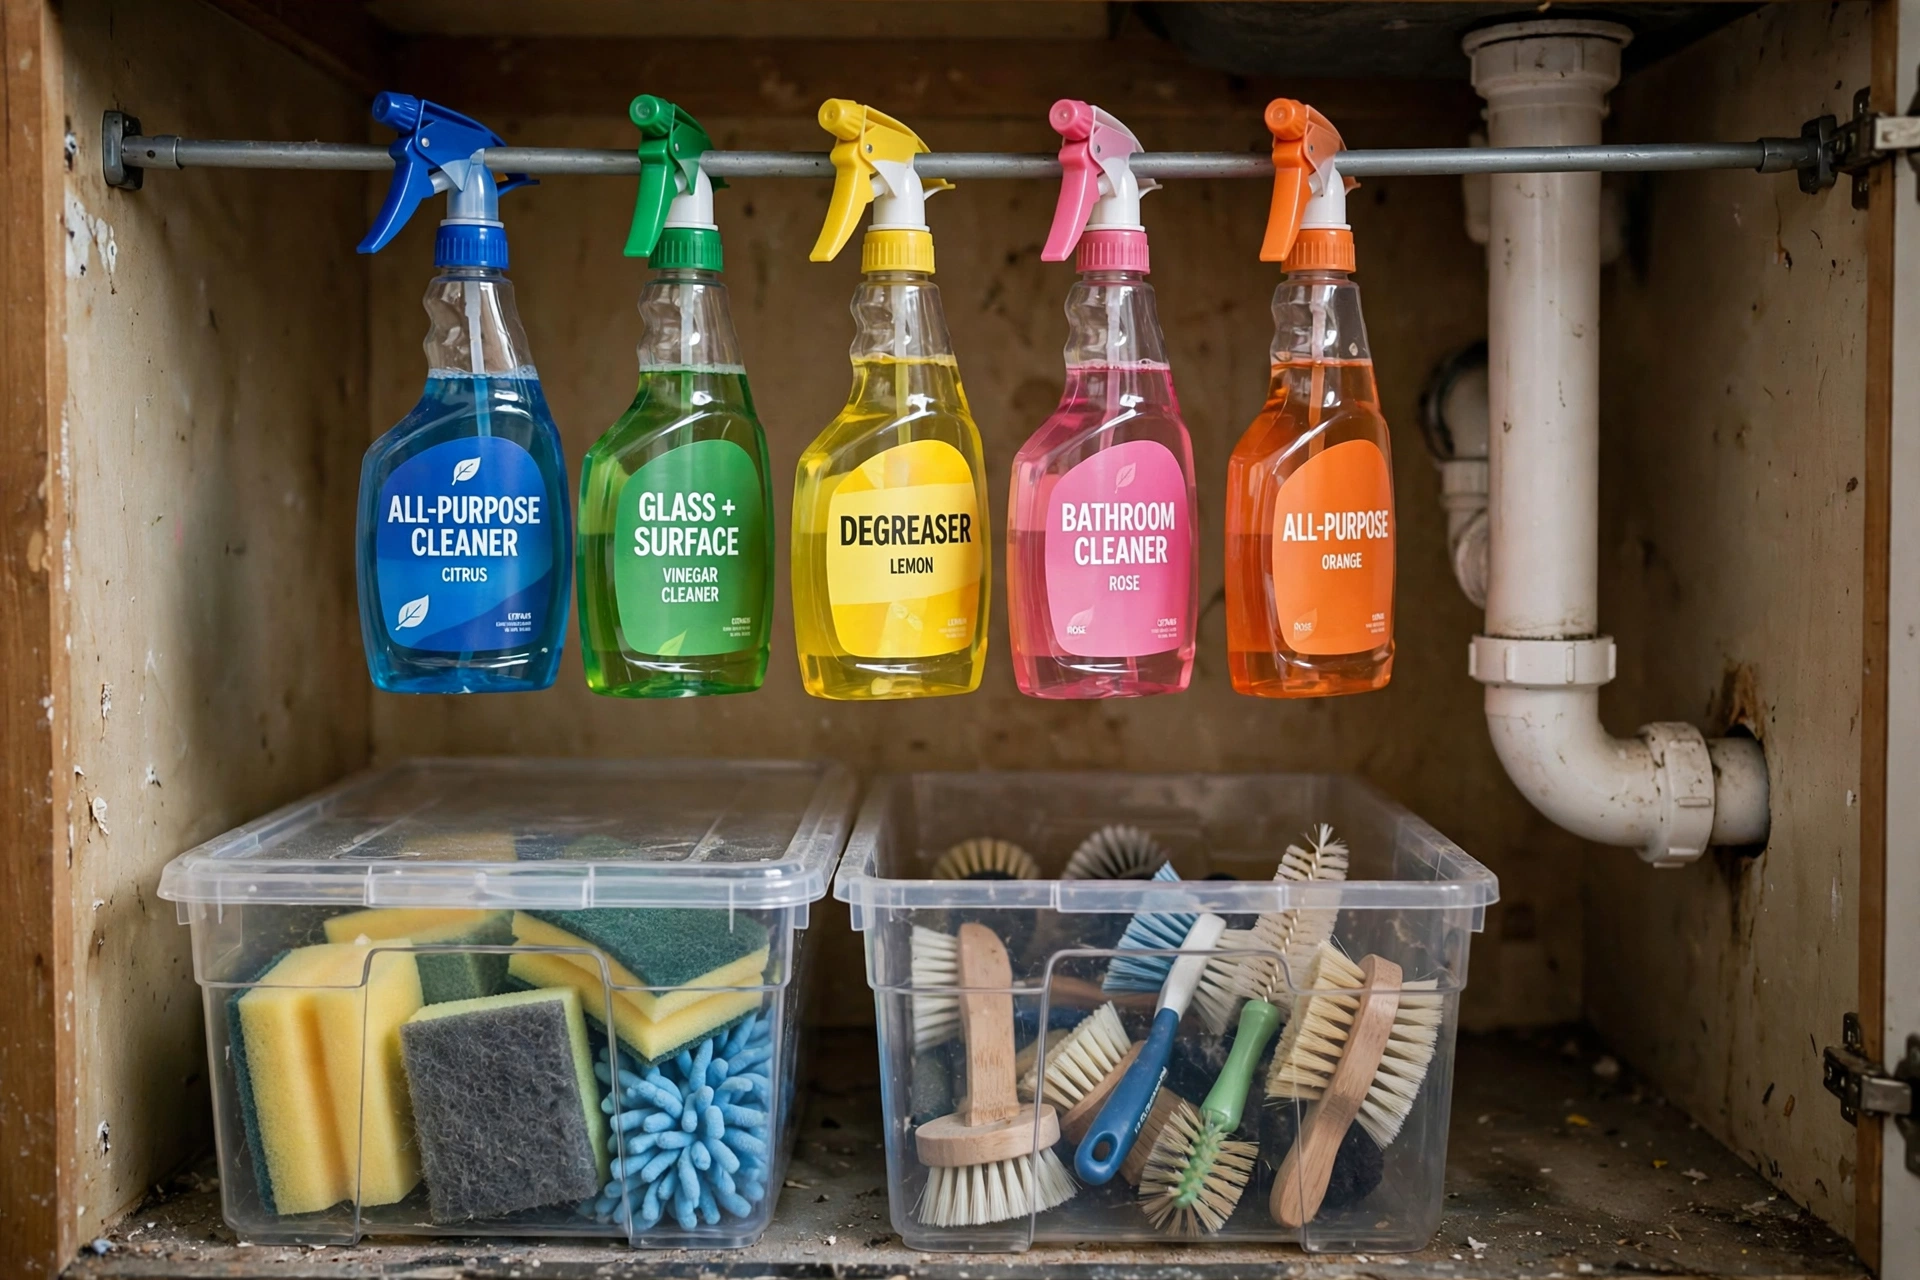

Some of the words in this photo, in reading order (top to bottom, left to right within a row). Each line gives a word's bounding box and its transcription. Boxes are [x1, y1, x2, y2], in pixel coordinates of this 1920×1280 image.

[387, 494, 541, 525] ALL-PURPOSE
[638, 491, 716, 523] GLASS
[721, 499, 736, 517] +
[1061, 501, 1175, 532] BATHROOM
[840, 513, 972, 546] DEGREASER
[1282, 510, 1389, 542] ALL-PURPOSE
[411, 526, 518, 557] CLEANER
[633, 526, 739, 557] SURFACE
[1074, 536, 1168, 566] CLEANER
[441, 566, 488, 583] CITRUS
[662, 566, 719, 583] VINEGAR
[890, 556, 934, 574] LEMON
[1321, 552, 1363, 570] ORANGE
[661, 586, 720, 603] CLEANER
[1108, 574, 1140, 591] ROSE
